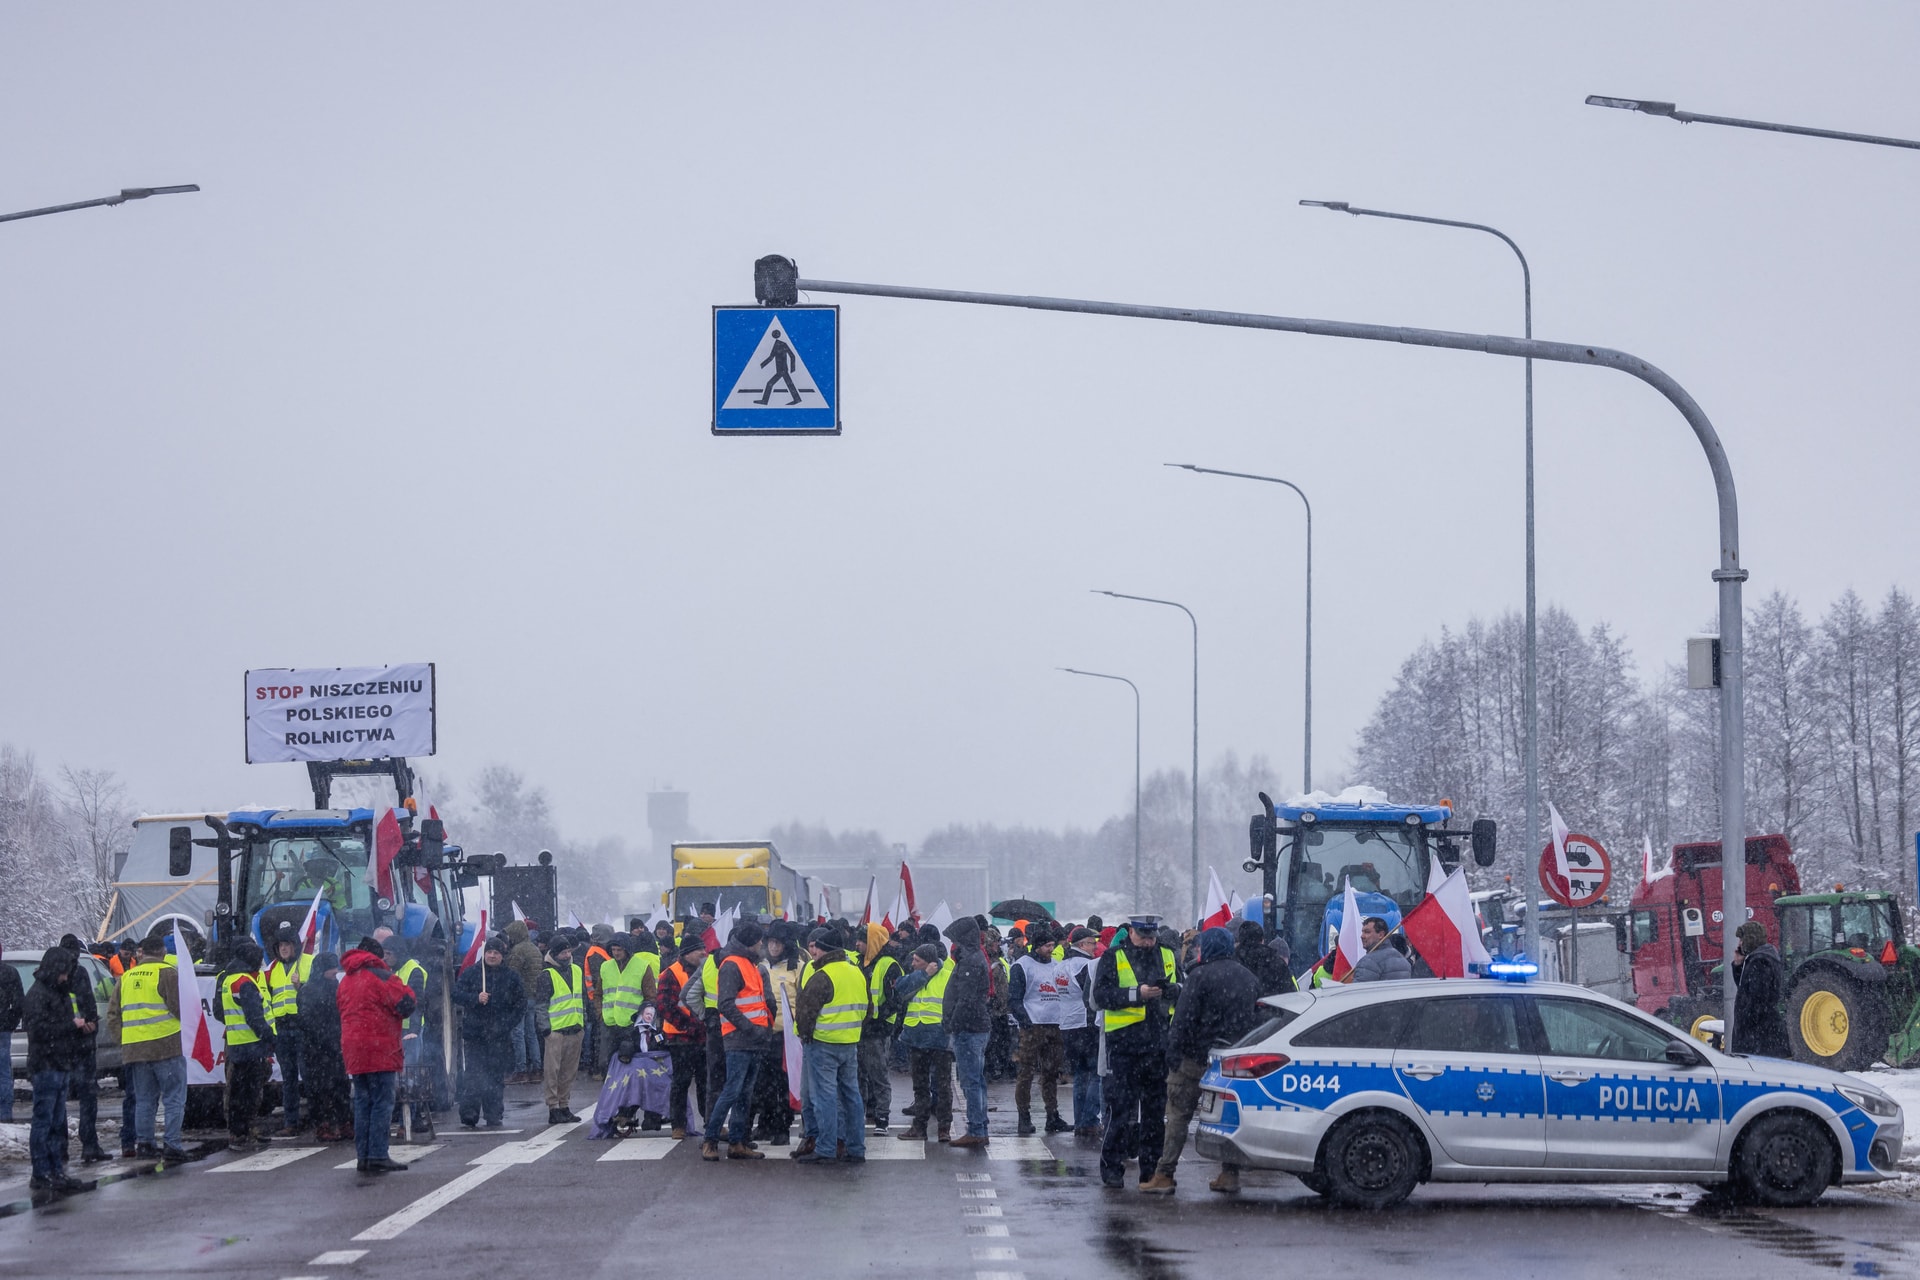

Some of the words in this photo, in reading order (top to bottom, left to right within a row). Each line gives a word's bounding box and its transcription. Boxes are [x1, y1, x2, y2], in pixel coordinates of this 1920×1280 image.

[256, 685, 304, 700] STOP
[310, 680, 423, 698] NISZCZENIU
[286, 704, 393, 722] POLSKIEGO
[285, 728, 395, 745] ROLNICTWA
[1282, 1074, 1341, 1094] D844
[1599, 1085, 1701, 1112] POLICJA
